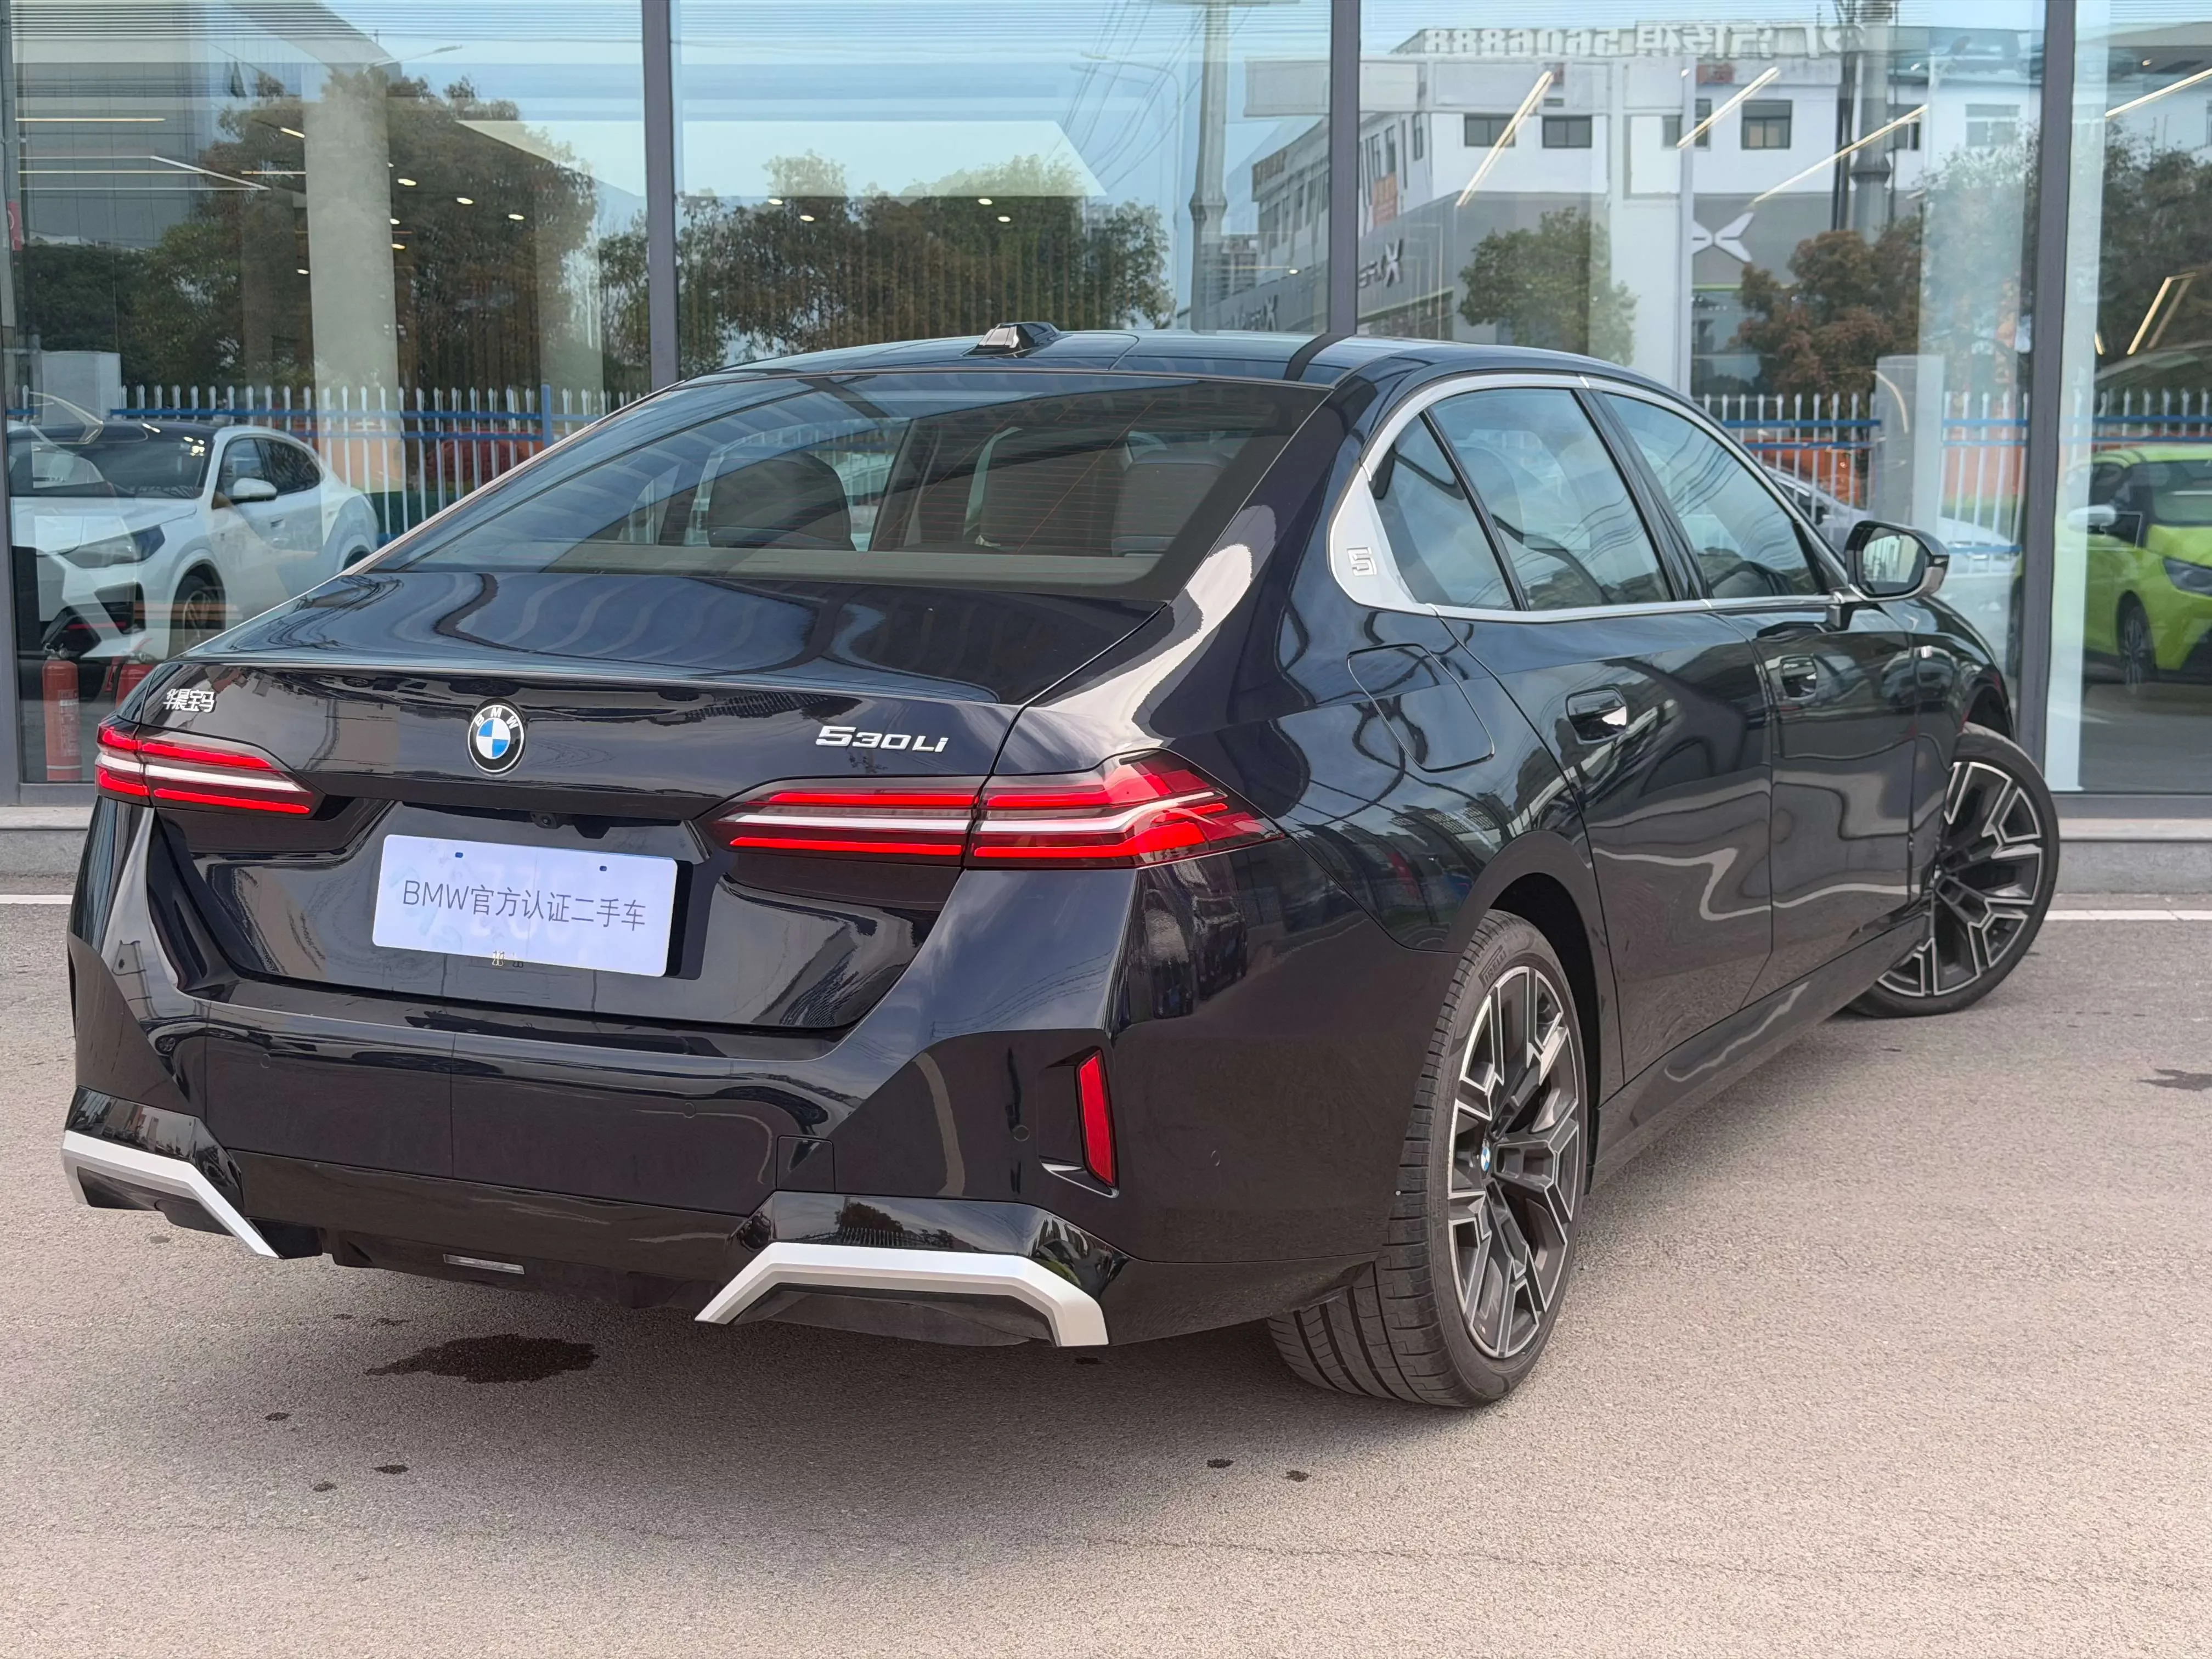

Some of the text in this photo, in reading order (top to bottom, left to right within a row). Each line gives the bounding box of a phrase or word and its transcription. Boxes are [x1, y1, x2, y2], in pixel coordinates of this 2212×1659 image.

[1347, 547, 1377, 576] 5
[163, 689, 216, 713] 华晨宝马
[475, 707, 518, 729] BMW
[816, 726, 949, 752] 530Li
[403, 879, 646, 932] BMW官方认证二手车
[1478, 944, 1506, 988] PIRELLI
